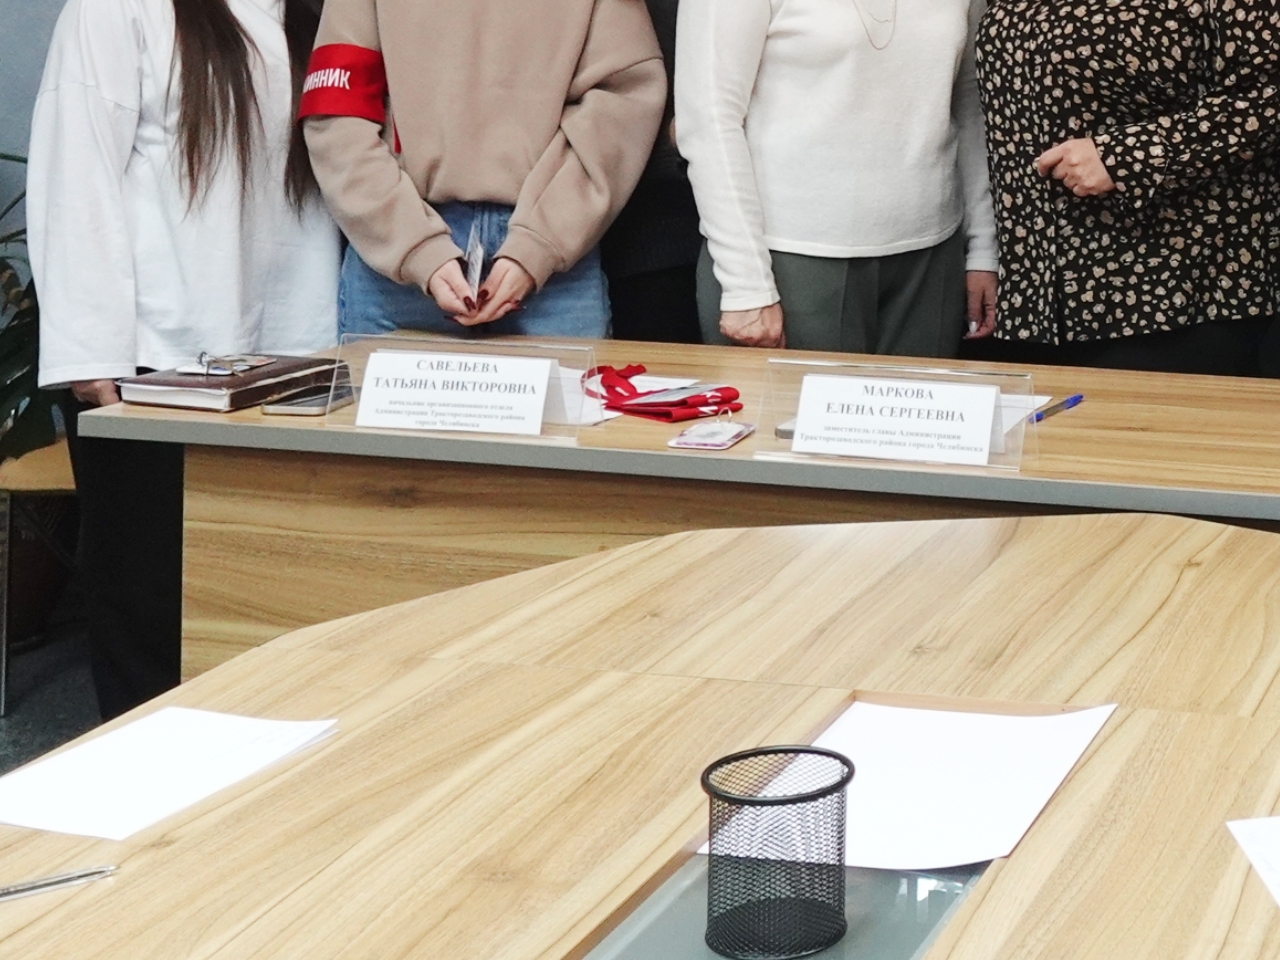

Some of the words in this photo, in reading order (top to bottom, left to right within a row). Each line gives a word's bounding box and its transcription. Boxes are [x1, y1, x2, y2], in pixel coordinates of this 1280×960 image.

[303, 68, 351, 94] ИННИК
[416, 359, 499, 374] САВЕЛЬЕВА
[373, 377, 436, 391] ТАТЬЯНА
[441, 380, 537, 395] ВИКТОРОВНА
[862, 385, 934, 400] МАРКОВА
[826, 402, 874, 417] ЕЛЕНА
[879, 406, 965, 422] СЕРГЕЕВНА
